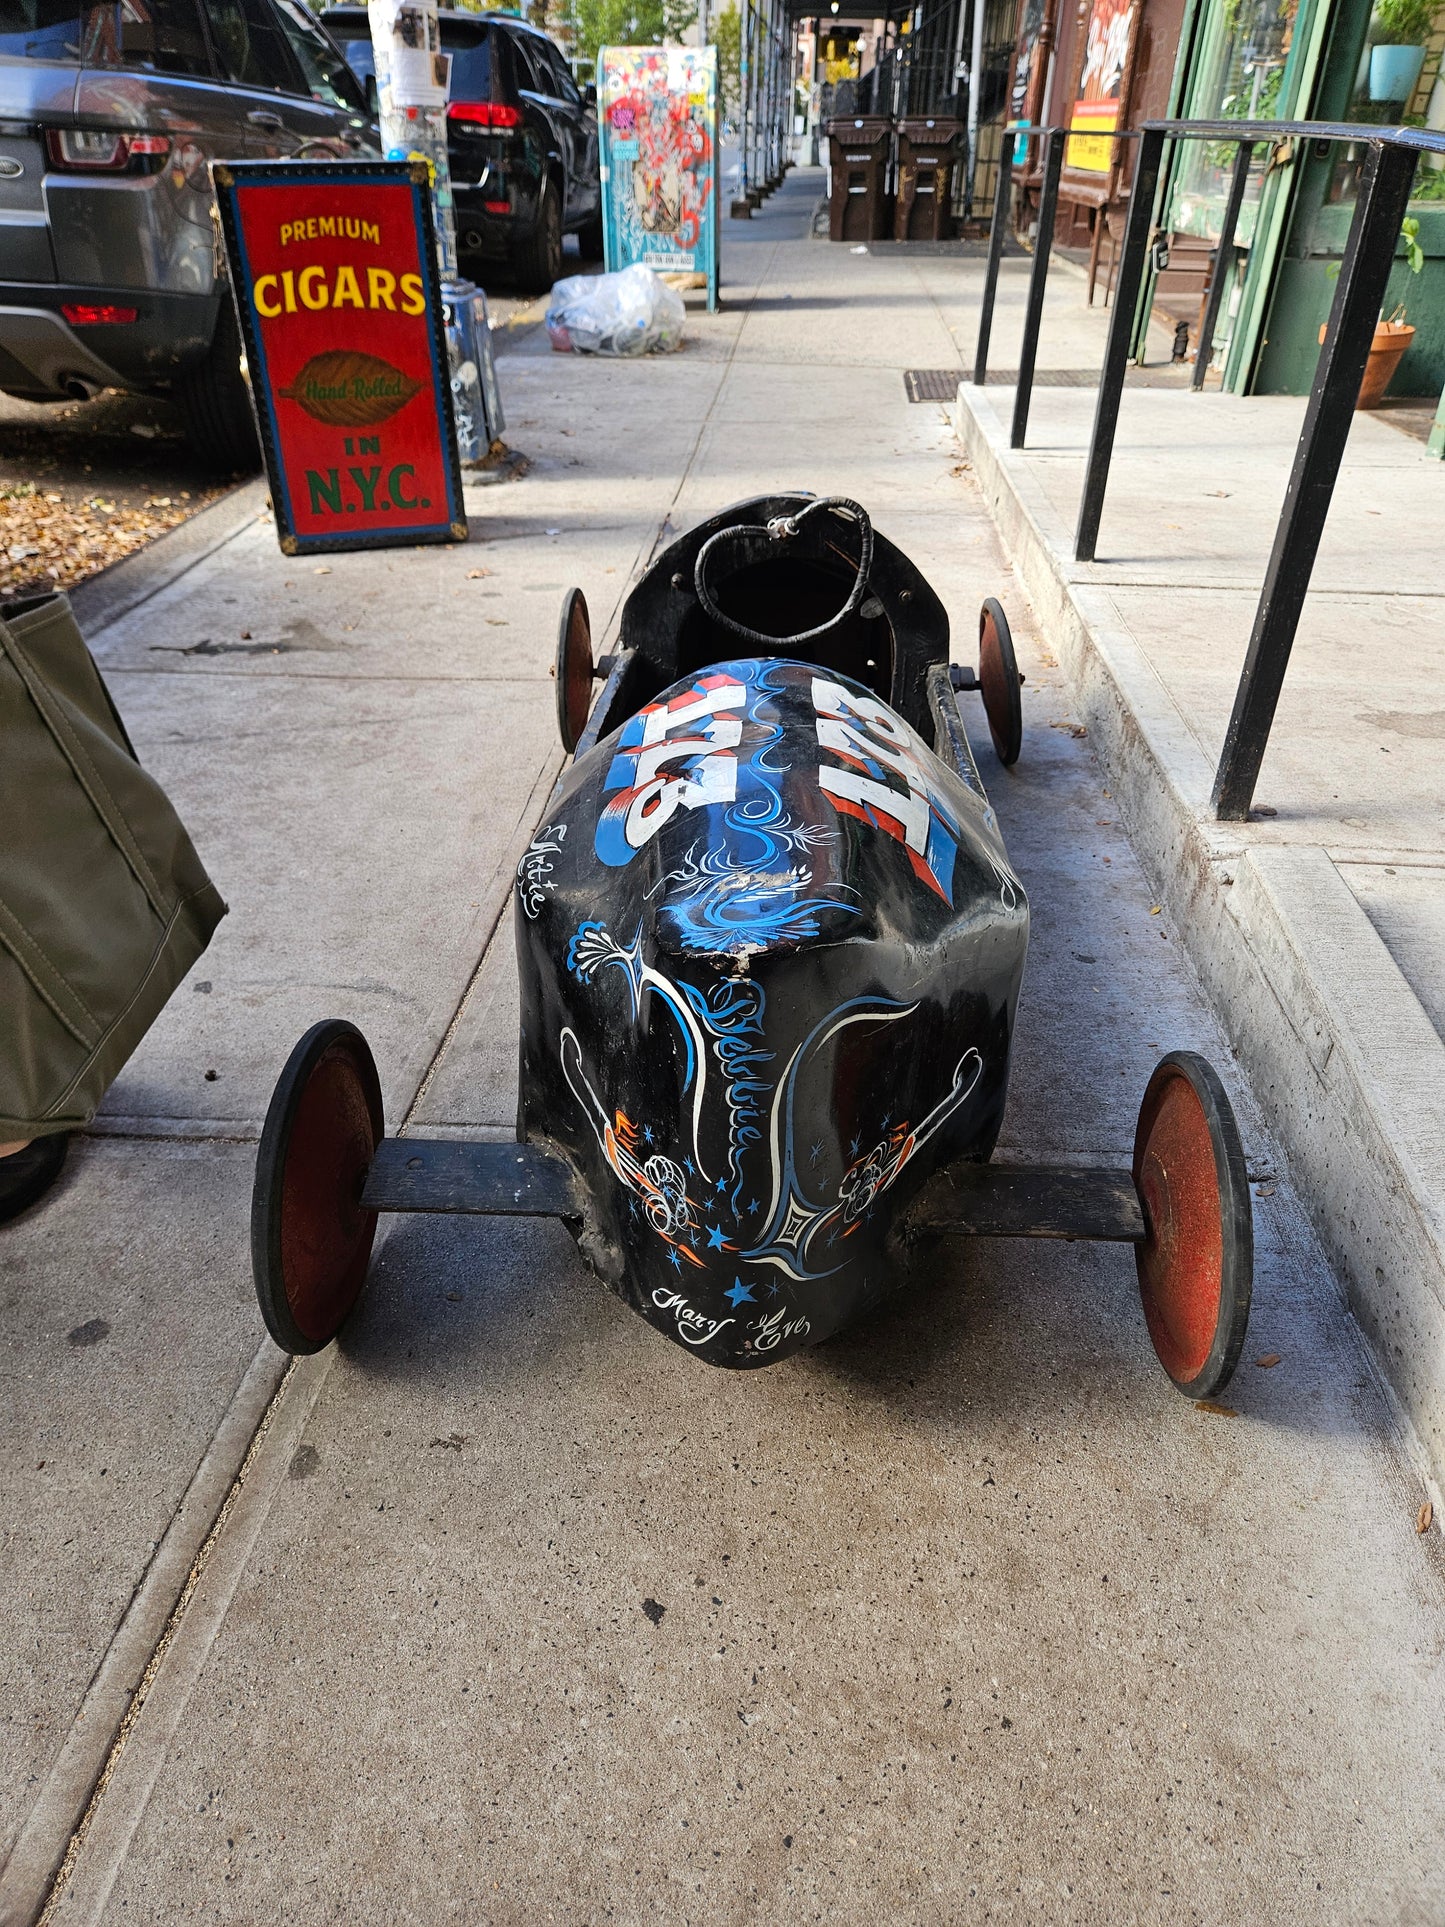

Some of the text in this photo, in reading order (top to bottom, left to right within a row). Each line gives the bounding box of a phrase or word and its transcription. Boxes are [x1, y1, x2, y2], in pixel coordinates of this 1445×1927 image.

[280, 216, 381, 246] PREMIUM
[253, 265, 427, 318] CIGARS
[344, 435, 381, 456] IN
[306, 463, 432, 515] N.Y.C.
[651, 1287, 737, 1345] Mary
